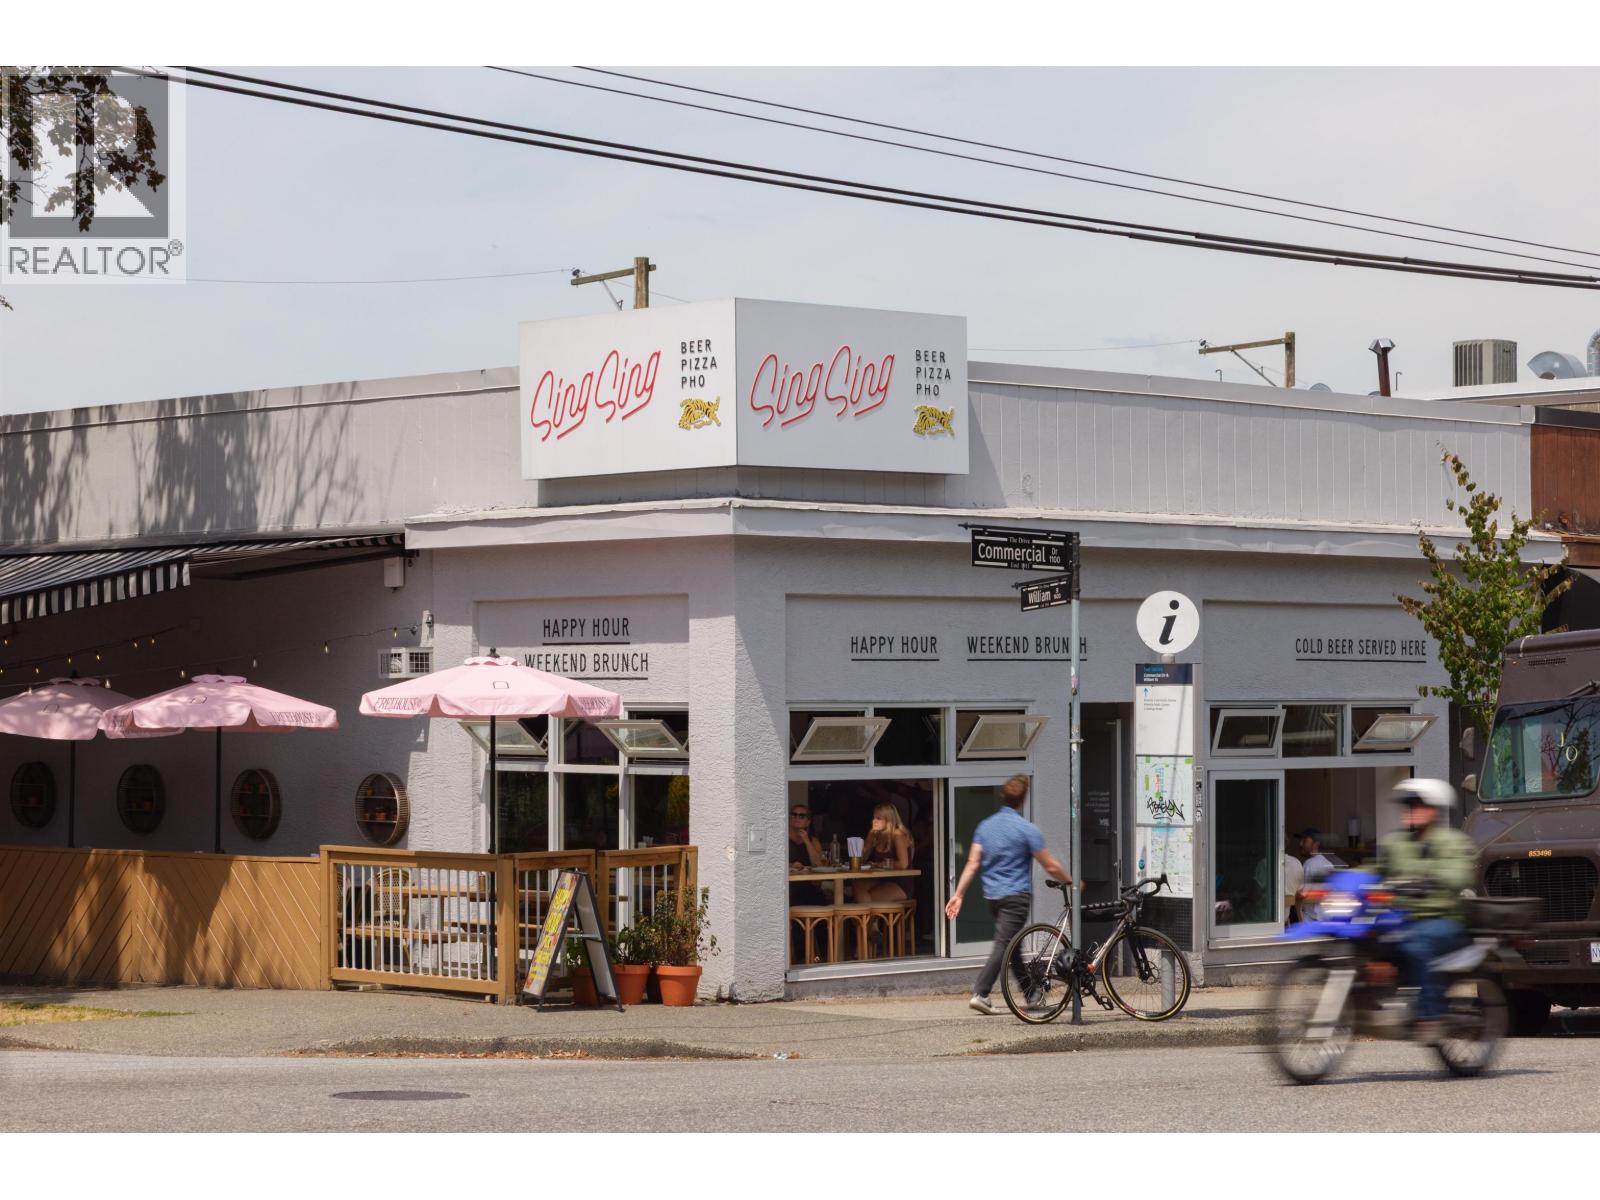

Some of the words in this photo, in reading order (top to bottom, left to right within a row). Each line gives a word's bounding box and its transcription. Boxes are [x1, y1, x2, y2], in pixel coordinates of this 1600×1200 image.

[680, 339, 713, 354] BEER
[680, 356, 718, 372] PIZZA
[914, 349, 946, 364] BEER
[915, 366, 951, 380] PIZZA
[680, 374, 706, 390] PHO
[916, 383, 940, 397] PHO
[978, 543, 1046, 562] Commercial
[1028, 589, 1051, 604] William
[543, 618, 587, 638] HAPPY
[592, 617, 630, 637] HOUR
[851, 636, 895, 654] HAPPY
[901, 636, 938, 654] HOUR
[967, 636, 1030, 654] WEEKEND
[1035, 636, 1088, 654] BRUNH
[1295, 638, 1323, 654] COLD
[1327, 638, 1354, 655] BEER
[1358, 639, 1397, 656] SERVED
[1401, 640, 1427, 657] HERE
[524, 653, 587, 673] WEEKEND
[593, 652, 649, 673] BRUNCH
